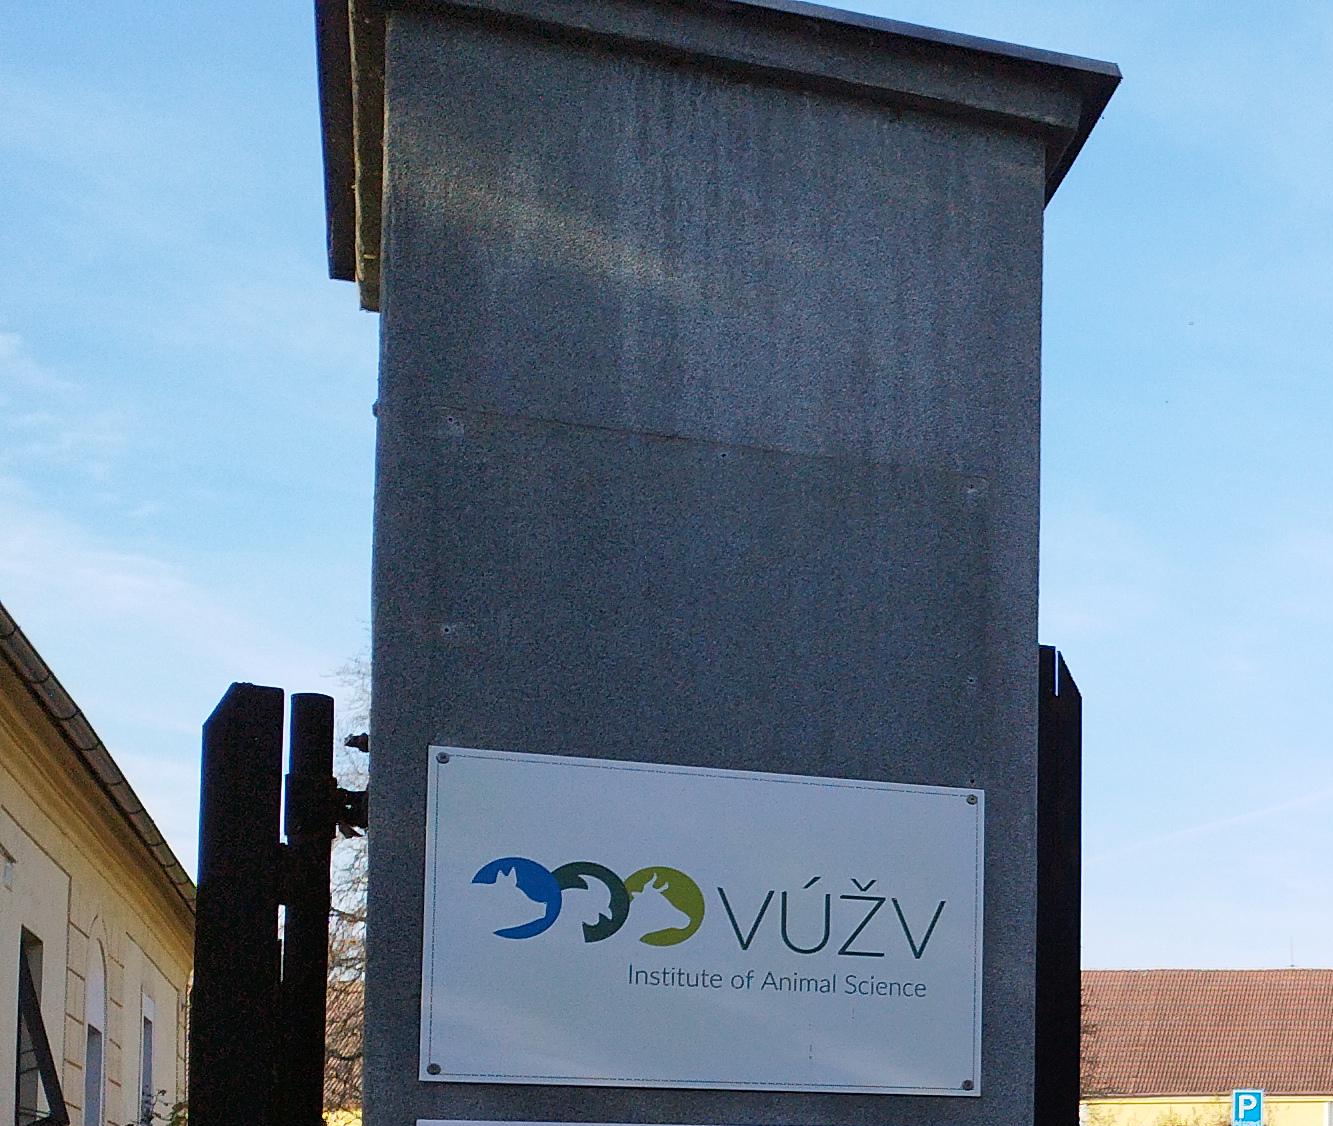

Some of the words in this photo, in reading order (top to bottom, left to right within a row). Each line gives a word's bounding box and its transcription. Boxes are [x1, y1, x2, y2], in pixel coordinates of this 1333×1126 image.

[717, 876, 946, 960] VÚŽV
[628, 964, 723, 990] Institute
[730, 968, 755, 990] of
[761, 970, 837, 994] Animal
[845, 974, 927, 998] Science
[1238, 1094, 1257, 1119] P
